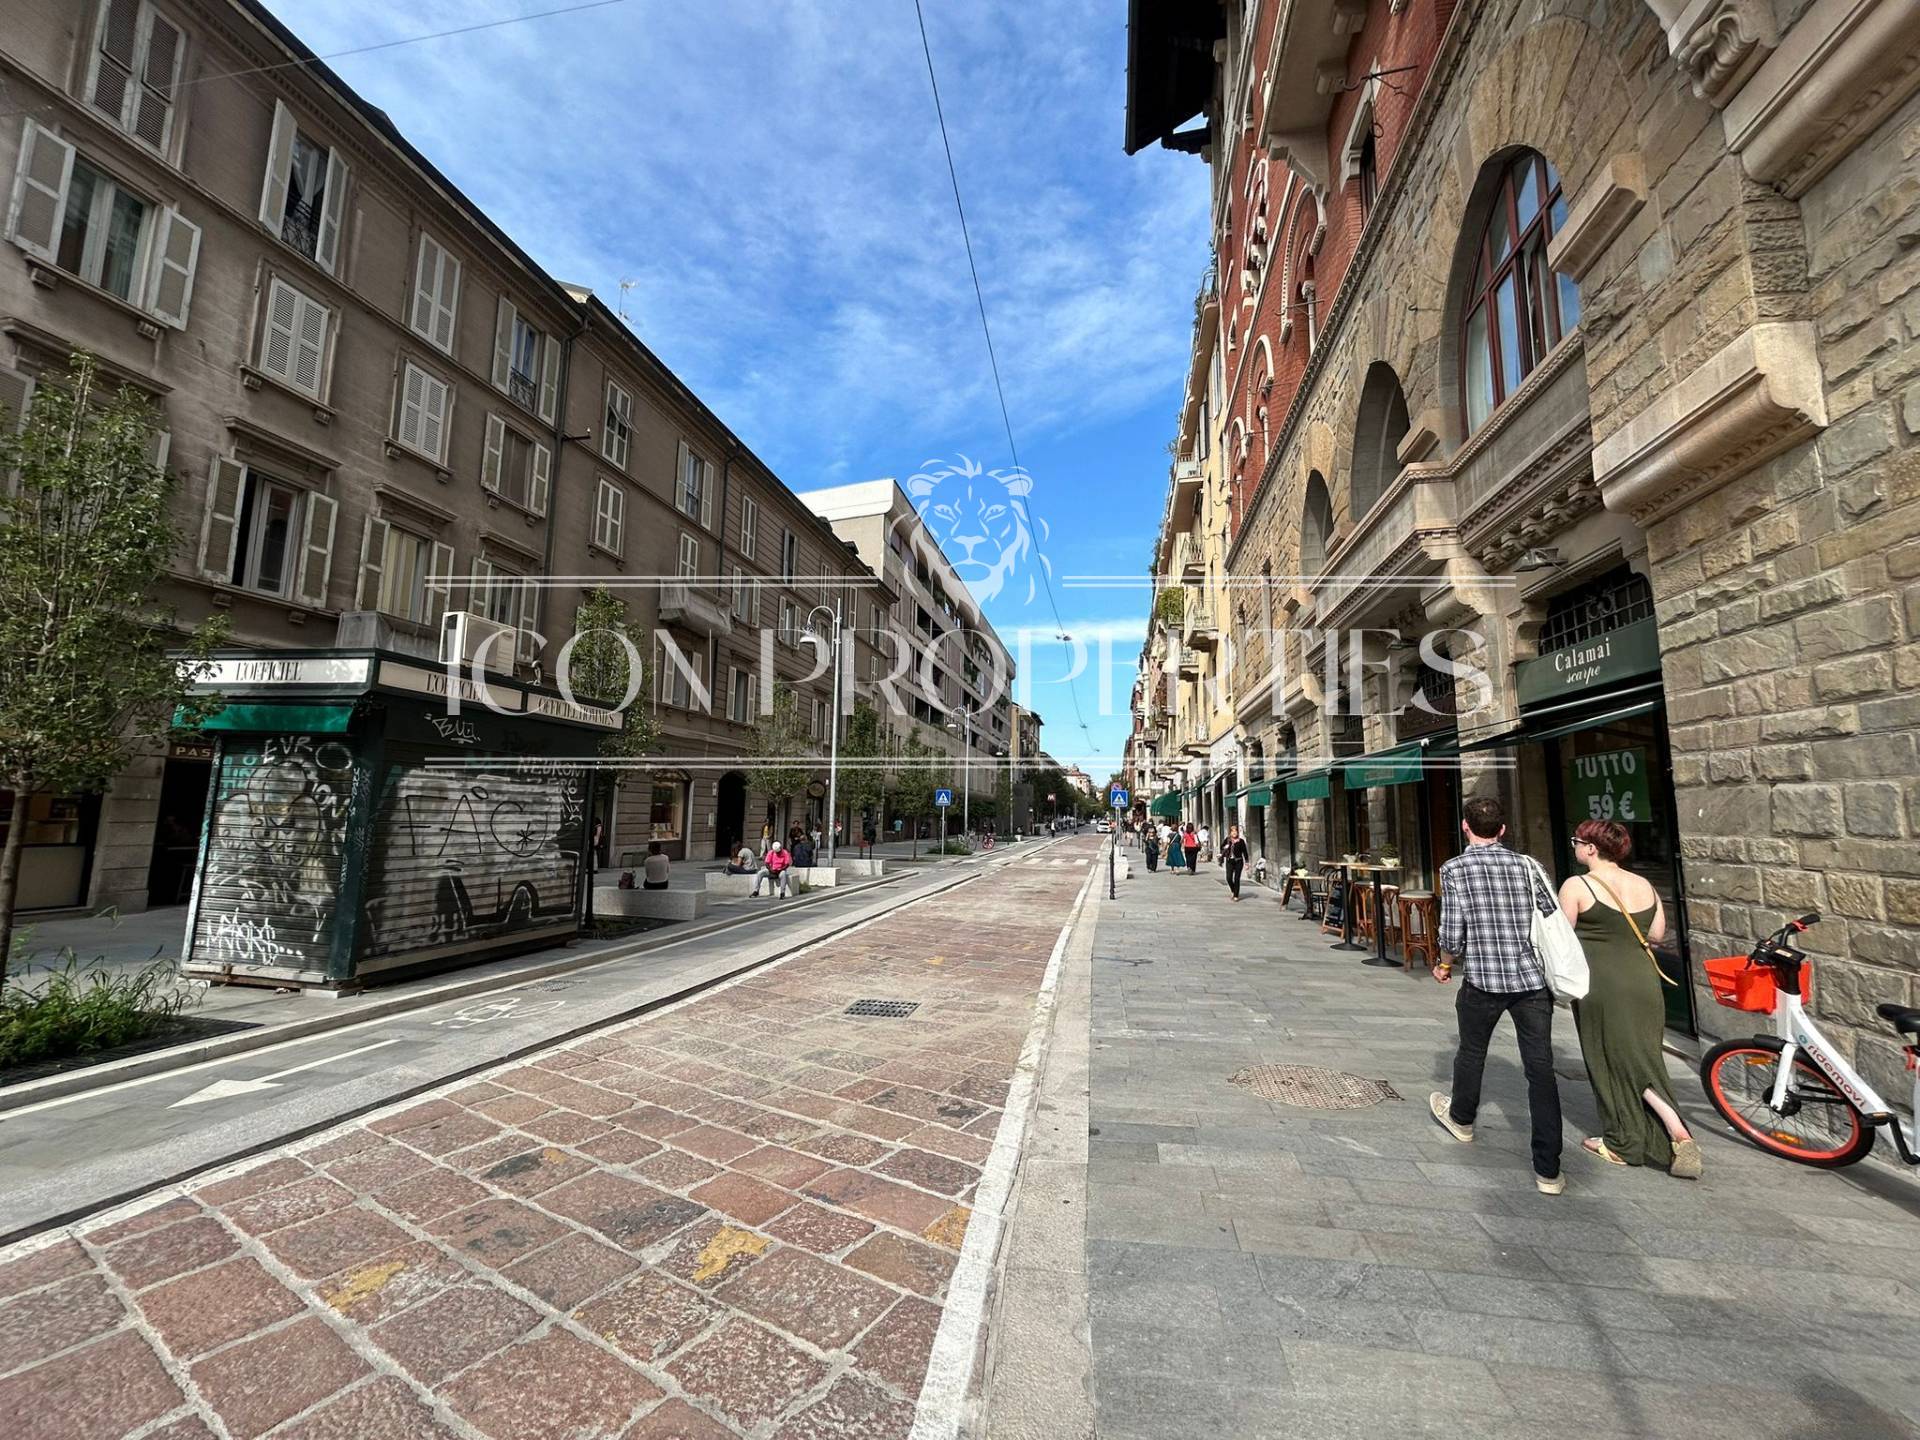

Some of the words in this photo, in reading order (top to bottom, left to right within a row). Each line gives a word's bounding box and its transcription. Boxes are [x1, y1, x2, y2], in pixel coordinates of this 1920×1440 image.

[1554, 637, 1611, 672] Calamai
[235, 661, 302, 682] L'OFFICIEL
[1566, 665, 1601, 685] scarpe
[1576, 752, 1636, 778] TUTTO
[1605, 779, 1614, 793] A
[1588, 794, 1615, 820] 59
[1619, 791, 1635, 820] €
[1808, 1045, 1865, 1107] ridemovi
